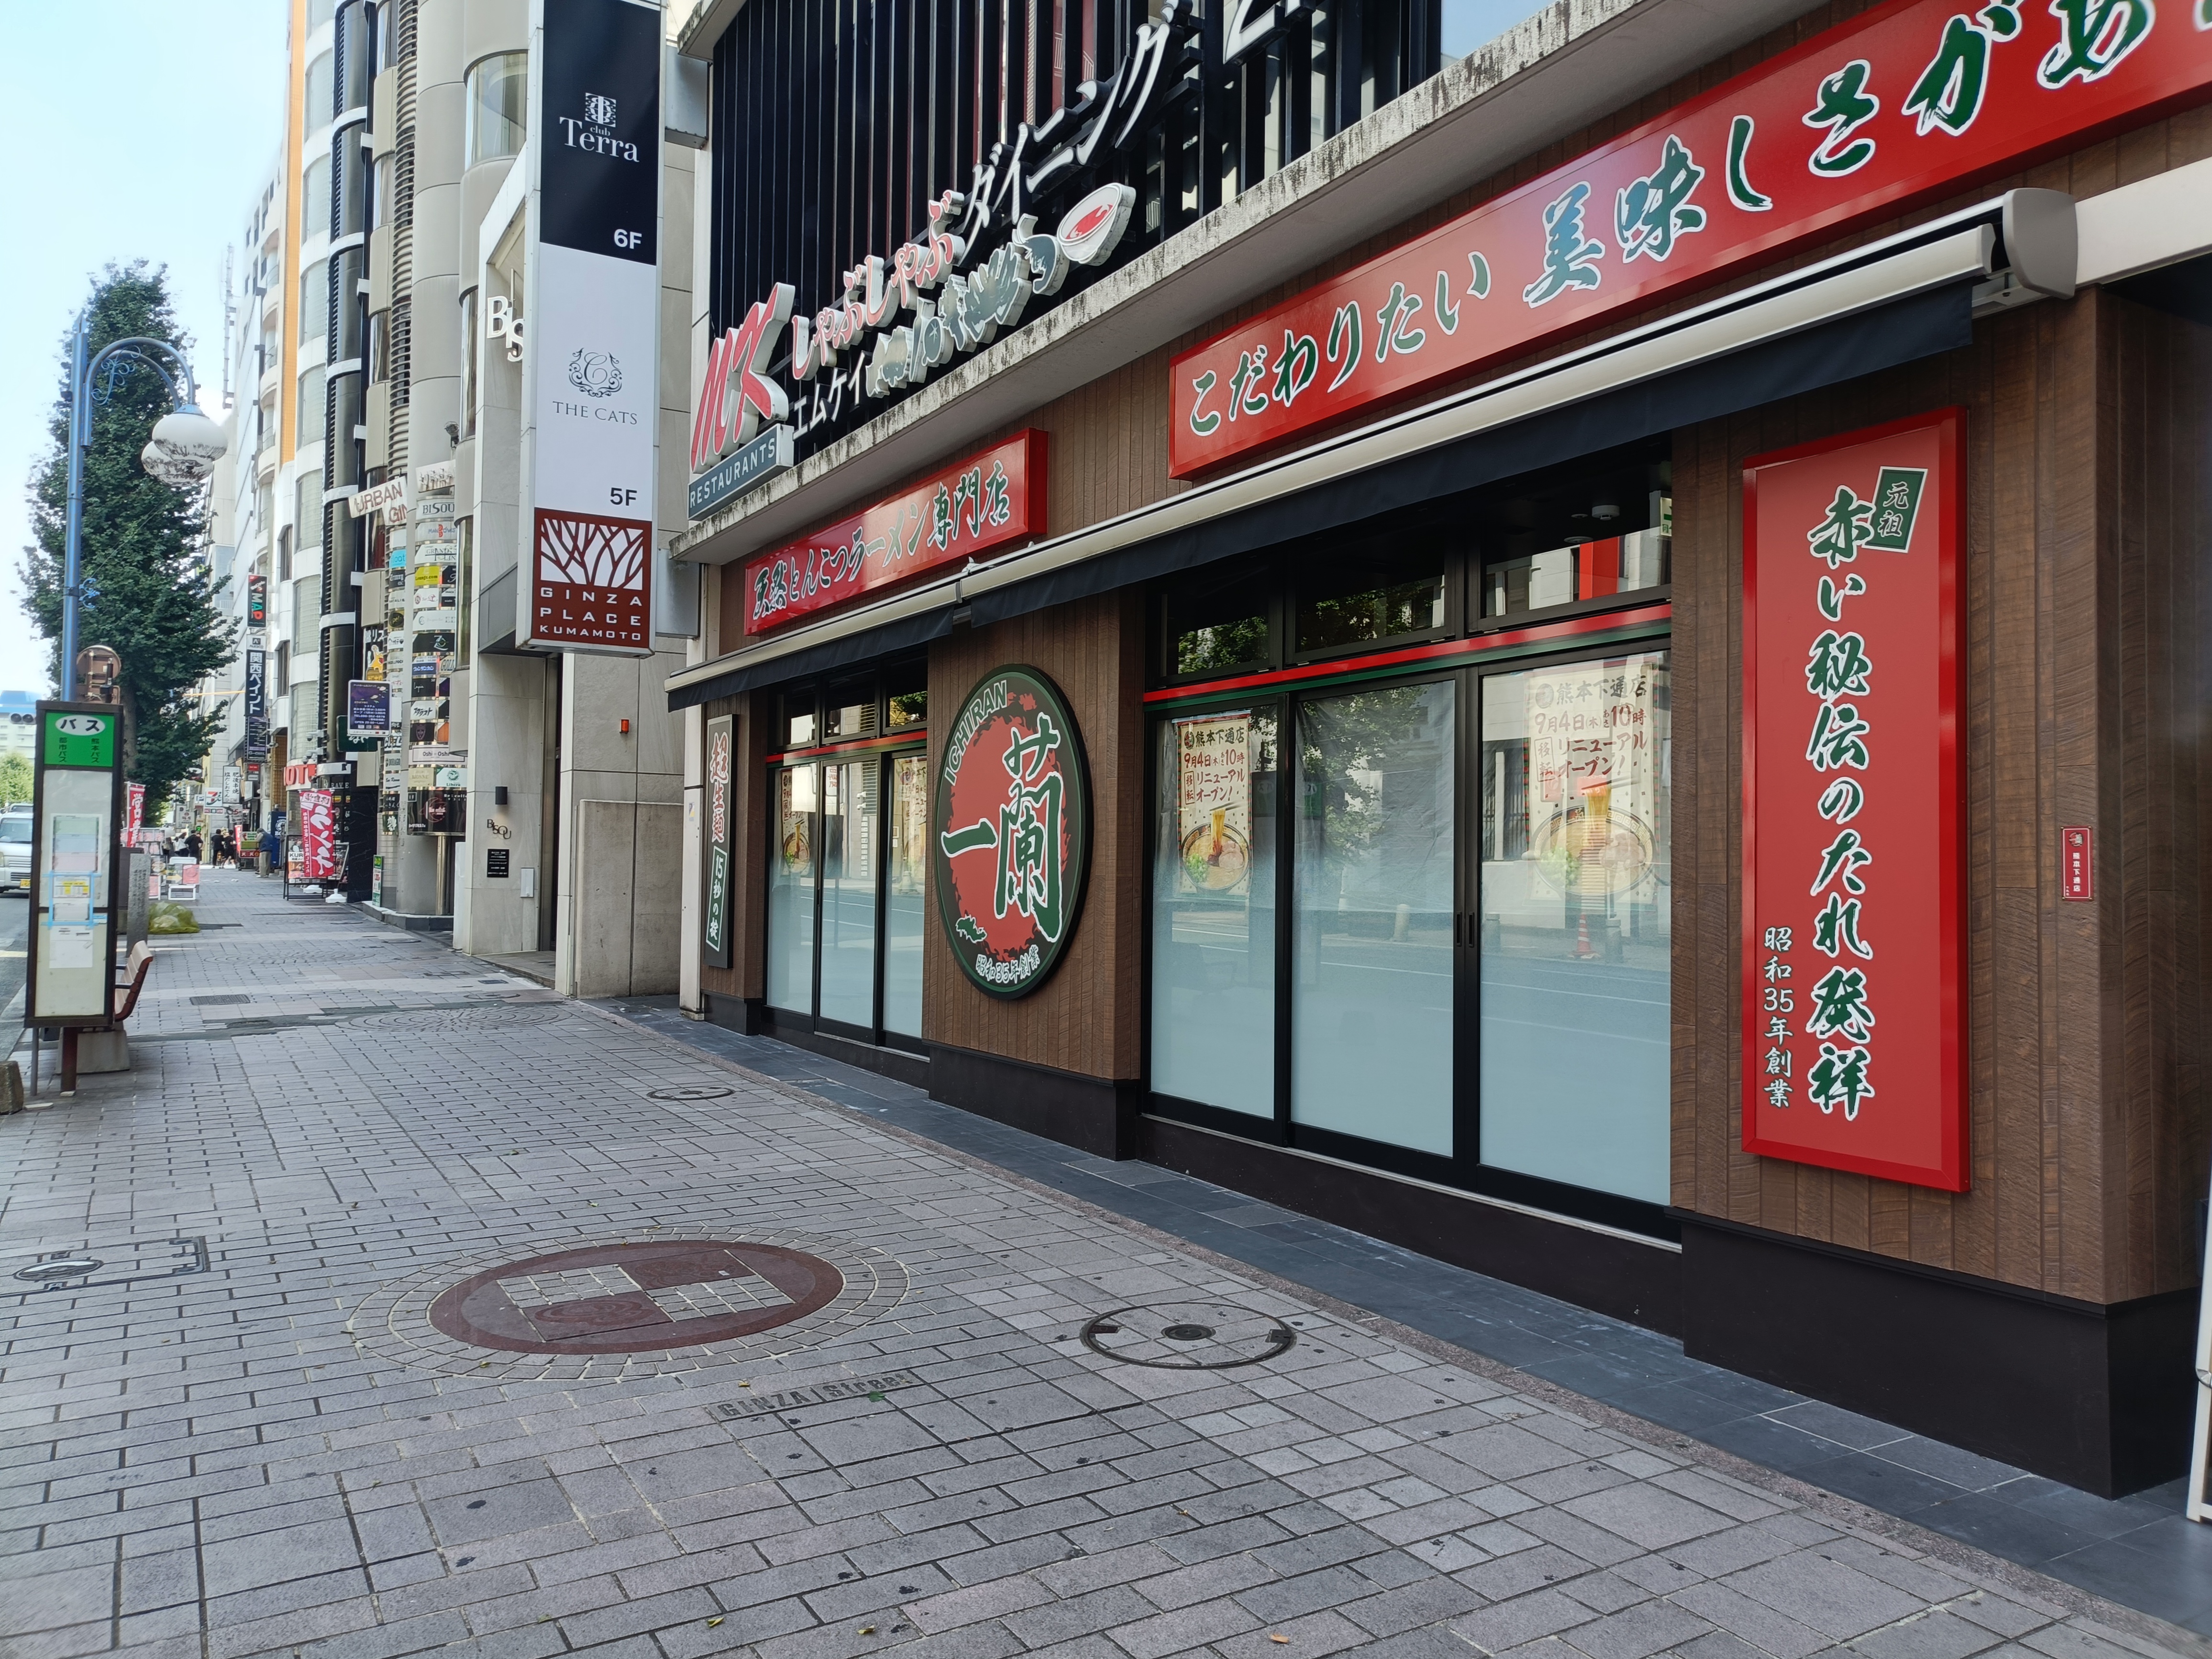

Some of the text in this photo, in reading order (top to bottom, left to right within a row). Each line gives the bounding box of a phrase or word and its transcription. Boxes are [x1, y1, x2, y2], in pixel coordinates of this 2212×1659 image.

[559, 116, 640, 163] Terra
[590, 126, 611, 137] club
[1522, 0, 2212, 309] 美味しさがあ
[614, 229, 642, 250] 6F
[1189, 251, 1492, 437] こだわりたい
[793, 351, 865, 441] エムケイ
[553, 401, 638, 425] THE CATS
[689, 437, 776, 509] RESTAURANTS
[354, 482, 403, 512] URBAN
[609, 487, 638, 507] 5F
[1878, 482, 1909, 537] 元祖
[752, 459, 1010, 620] 天然とんこつラーメン専門店
[540, 586, 642, 607] GINZA
[540, 607, 641, 626] PLACE
[540, 625, 641, 641] KUMAMOTO
[249, 652, 263, 713] 関西ペイント
[1556, 675, 1647, 704] 熊本下通店
[60, 719, 100, 732] バス
[944, 680, 1007, 786] ICHIRAN
[1195, 726, 1245, 748] 熊本下通店
[1558, 730, 1648, 754] リニューアル
[1185, 774, 1194, 801] 移転
[1197, 768, 1245, 786] リニューアル
[487, 818, 511, 840] BISOU
[941, 712, 1063, 943] 一蘭
[975, 945, 1040, 984] 昭和35年創業
[1763, 926, 1794, 1108] 昭和35年創業
[718, 1371, 913, 1417] GINZA Street
